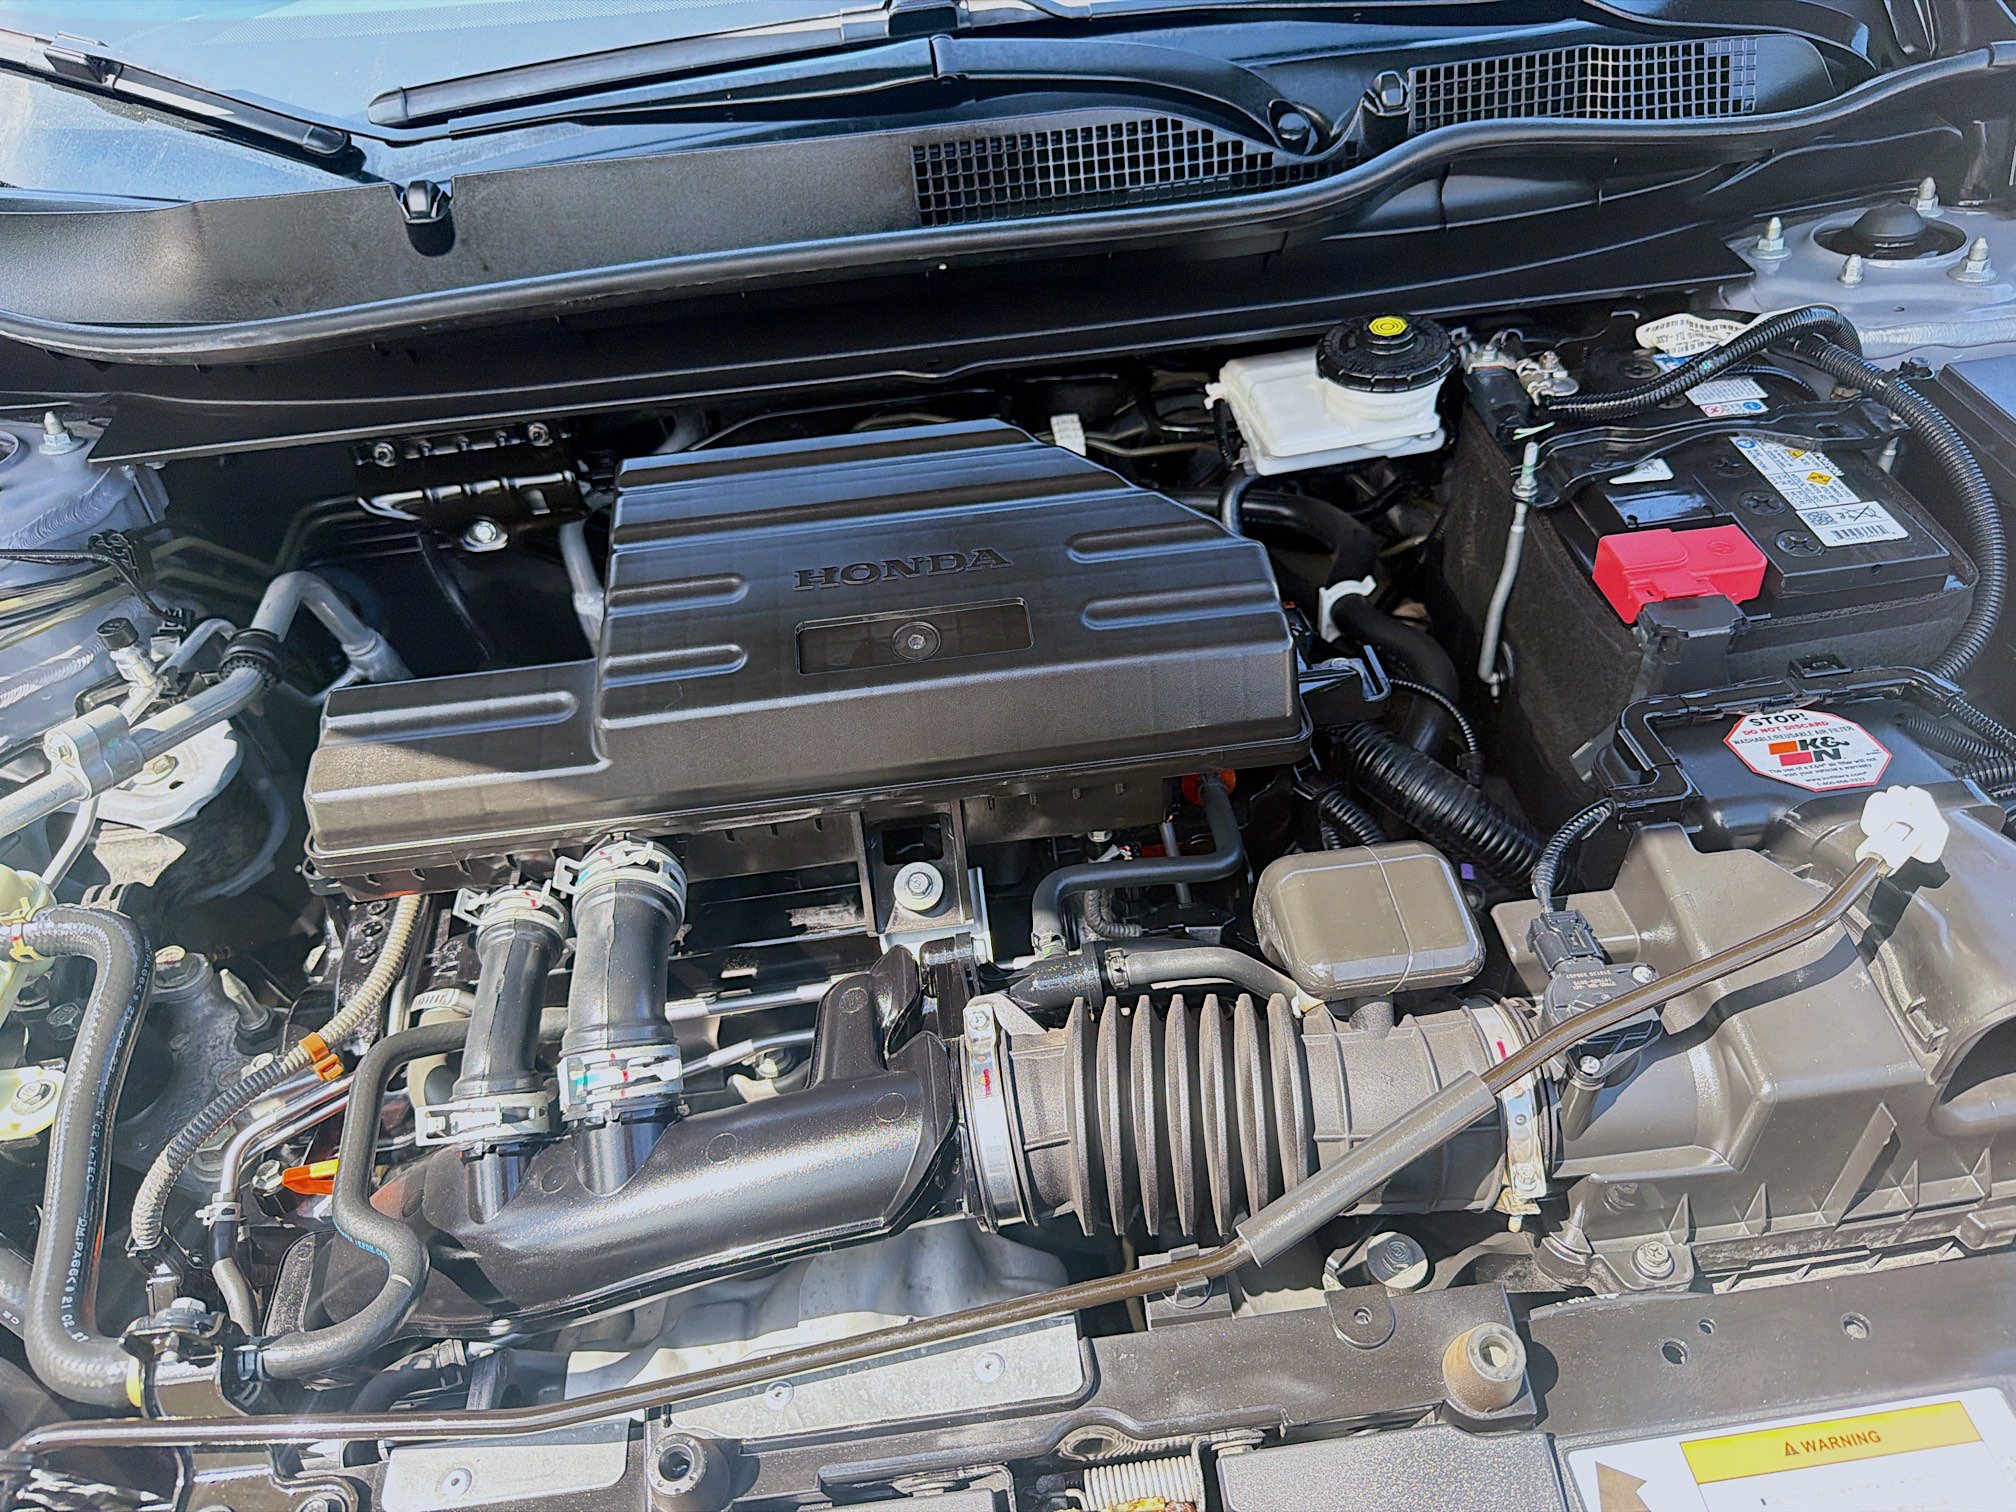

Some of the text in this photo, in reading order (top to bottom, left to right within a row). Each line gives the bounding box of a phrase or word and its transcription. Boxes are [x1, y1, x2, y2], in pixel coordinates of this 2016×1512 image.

[793, 548, 1014, 591] HONDA
[1748, 712, 1809, 726] STOP!
[1784, 722, 1829, 730] DISCARD
[1732, 730, 1815, 744] WASHABLE/REUSABLE
[1829, 725, 1854, 733] FILTER
[91, 1123, 101, 1138] C2
[86, 1145, 100, 1183] Y-TEC
[61, 1295, 73, 1310] 21
[61, 1313, 76, 1328] 02
[1800, 1430, 1882, 1454] WARNING
